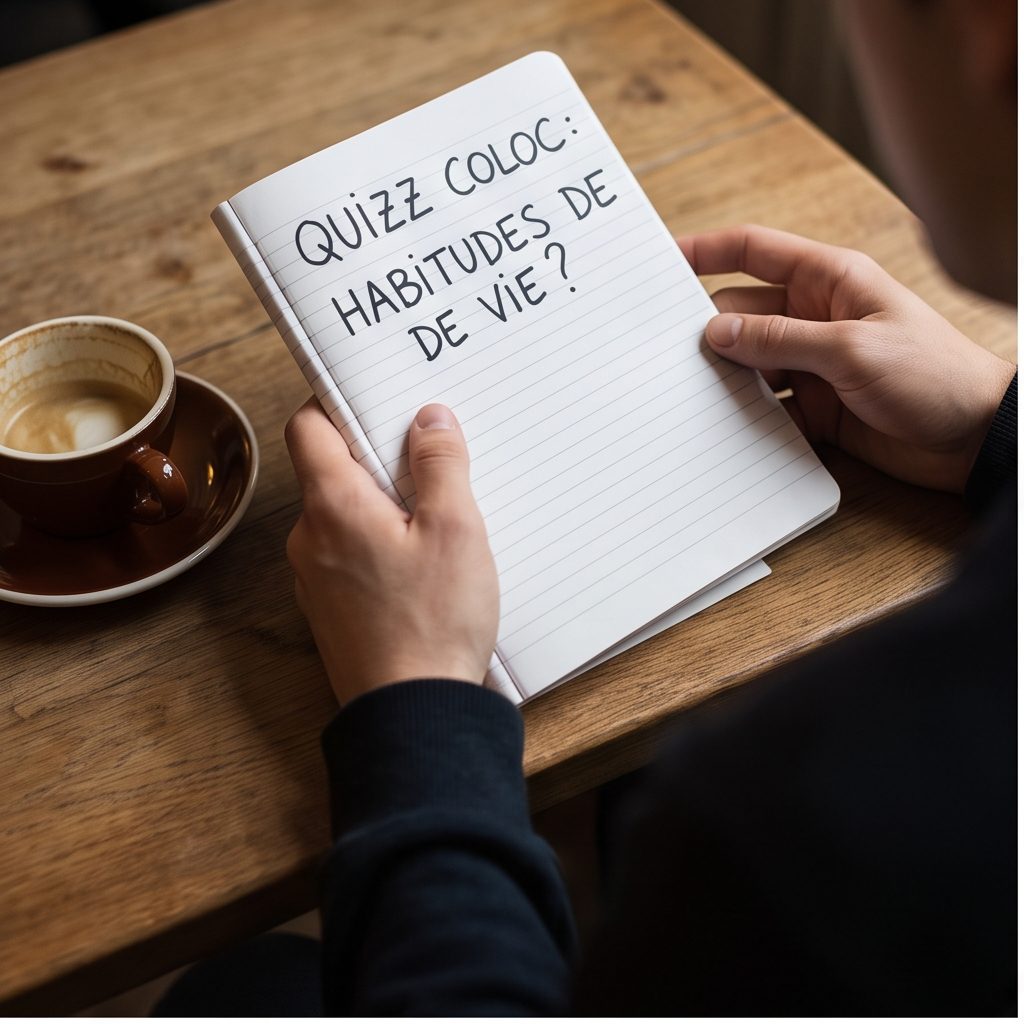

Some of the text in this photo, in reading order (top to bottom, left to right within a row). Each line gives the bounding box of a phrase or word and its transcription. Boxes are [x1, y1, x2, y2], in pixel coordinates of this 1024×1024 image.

[444, 116, 578, 196] COLOC:
[557, 169, 617, 221] DE
[407, 309, 469, 362] DE
